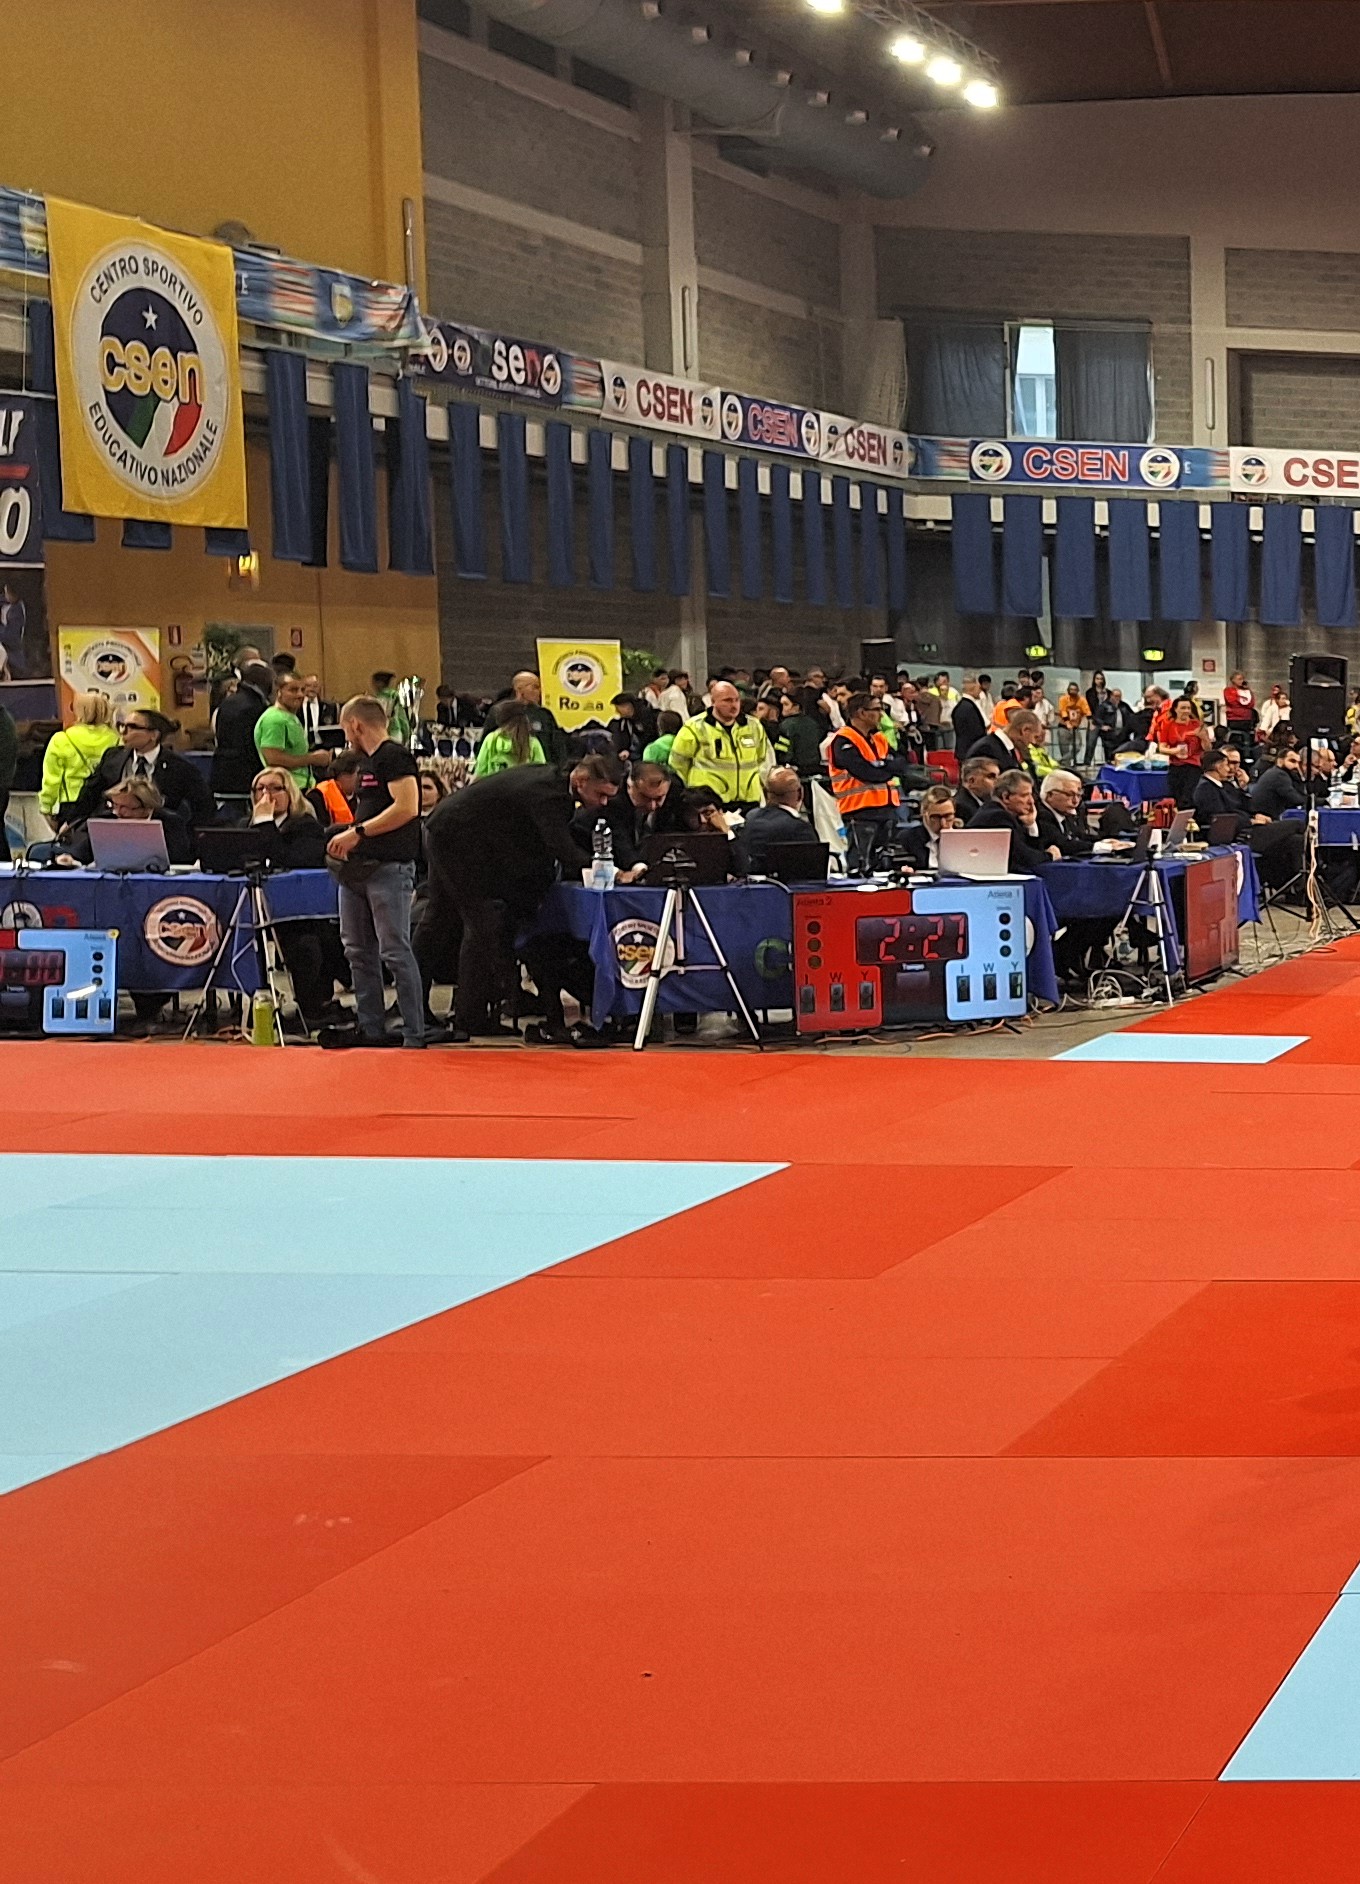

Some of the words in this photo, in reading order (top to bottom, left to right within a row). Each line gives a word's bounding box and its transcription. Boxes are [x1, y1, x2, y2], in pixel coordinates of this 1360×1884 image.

[90, 254, 139, 304] CENTRO
[142, 256, 204, 327] SPORTIVO
[99, 335, 206, 405] csen
[636, 379, 694, 426] CSEN
[747, 402, 799, 447] CSEN
[89, 400, 158, 486] EDUCATIVO
[160, 420, 218, 488] NAZIONALE
[844, 426, 888, 467] CSEN
[1022, 446, 1130, 481] CSEN
[879, 917, 966, 962] 2:27
[830, 972, 843, 982] W
[861, 971, 869, 982] Y
[983, 962, 995, 973] W
[1011, 961, 1019, 972] Y
